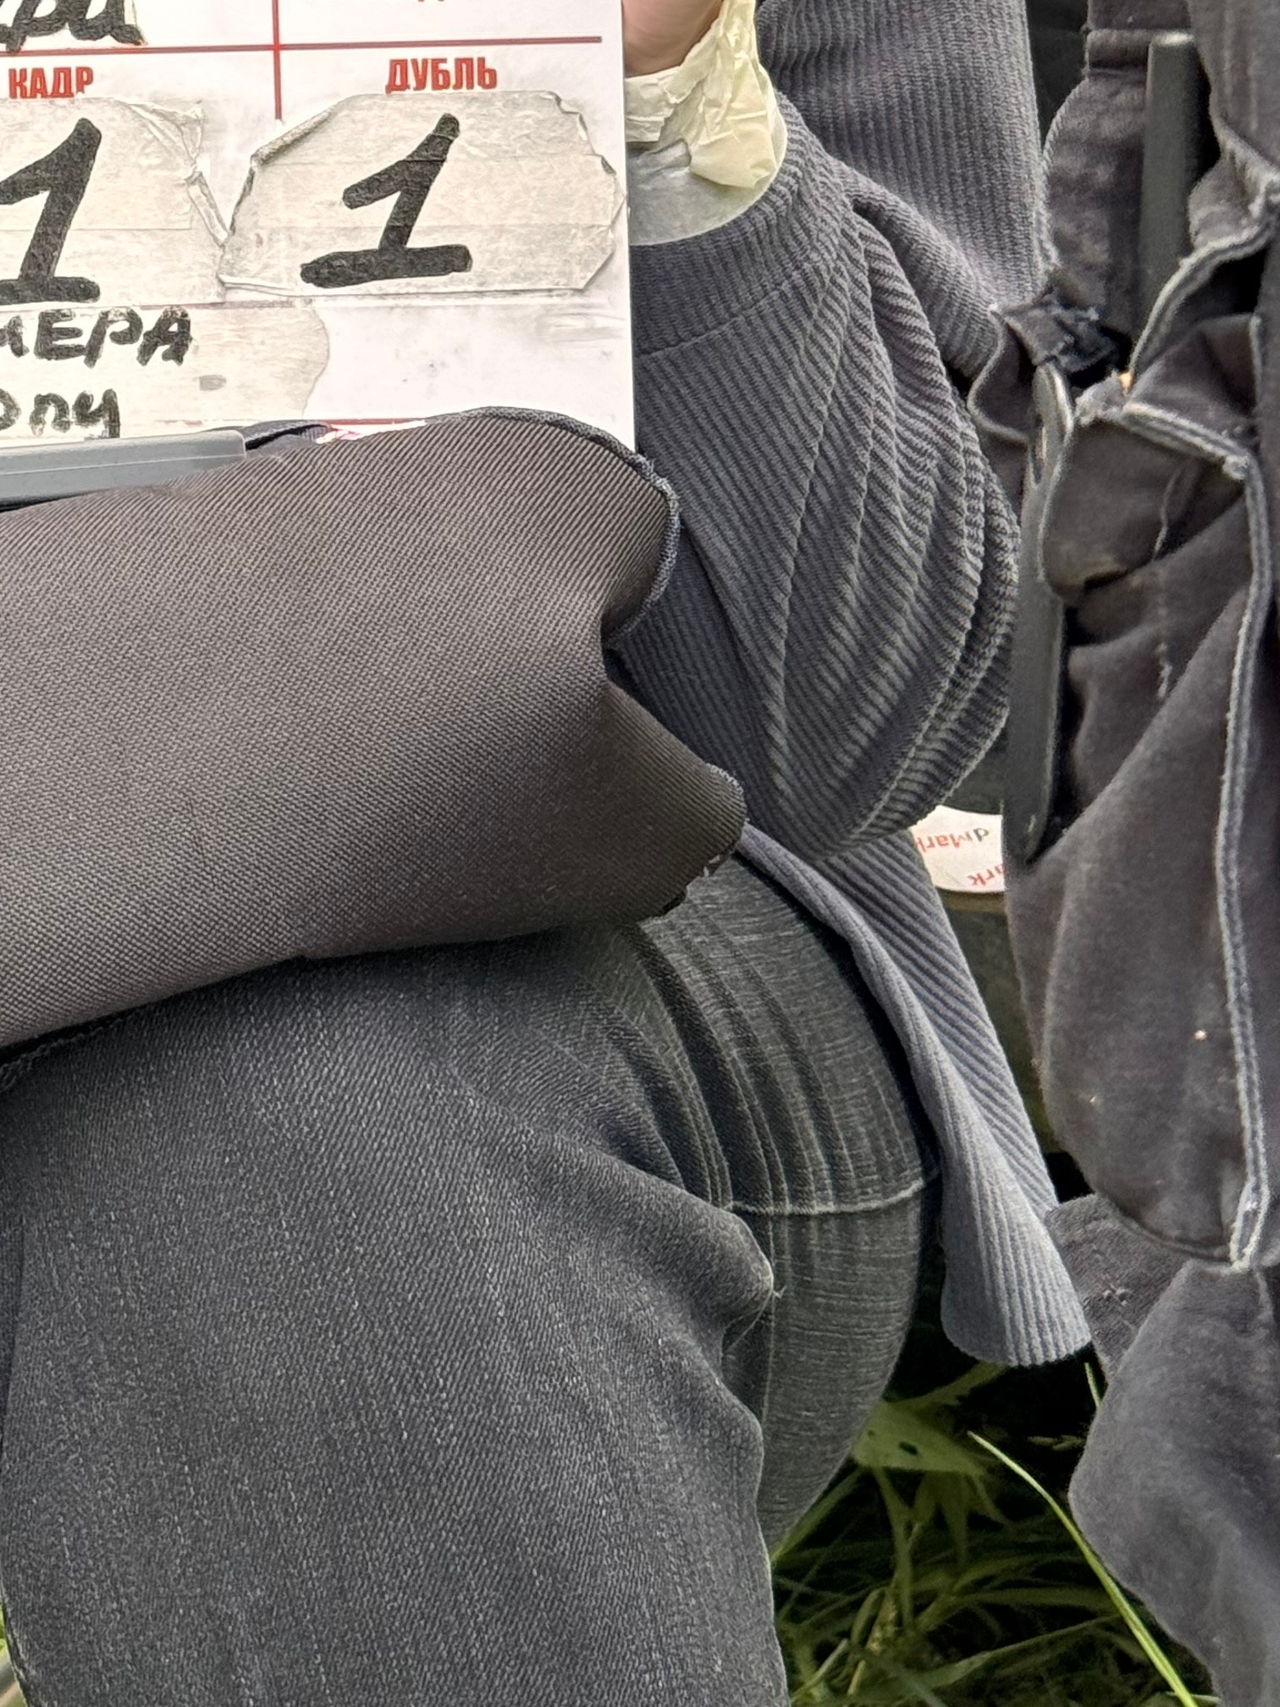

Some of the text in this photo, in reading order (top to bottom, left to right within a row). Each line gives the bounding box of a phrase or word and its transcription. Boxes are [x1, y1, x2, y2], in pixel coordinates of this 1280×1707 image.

[8, 66, 94, 99] КАДР
[385, 57, 498, 94] ДУБЛЬ
[300, 112, 474, 289] 1
